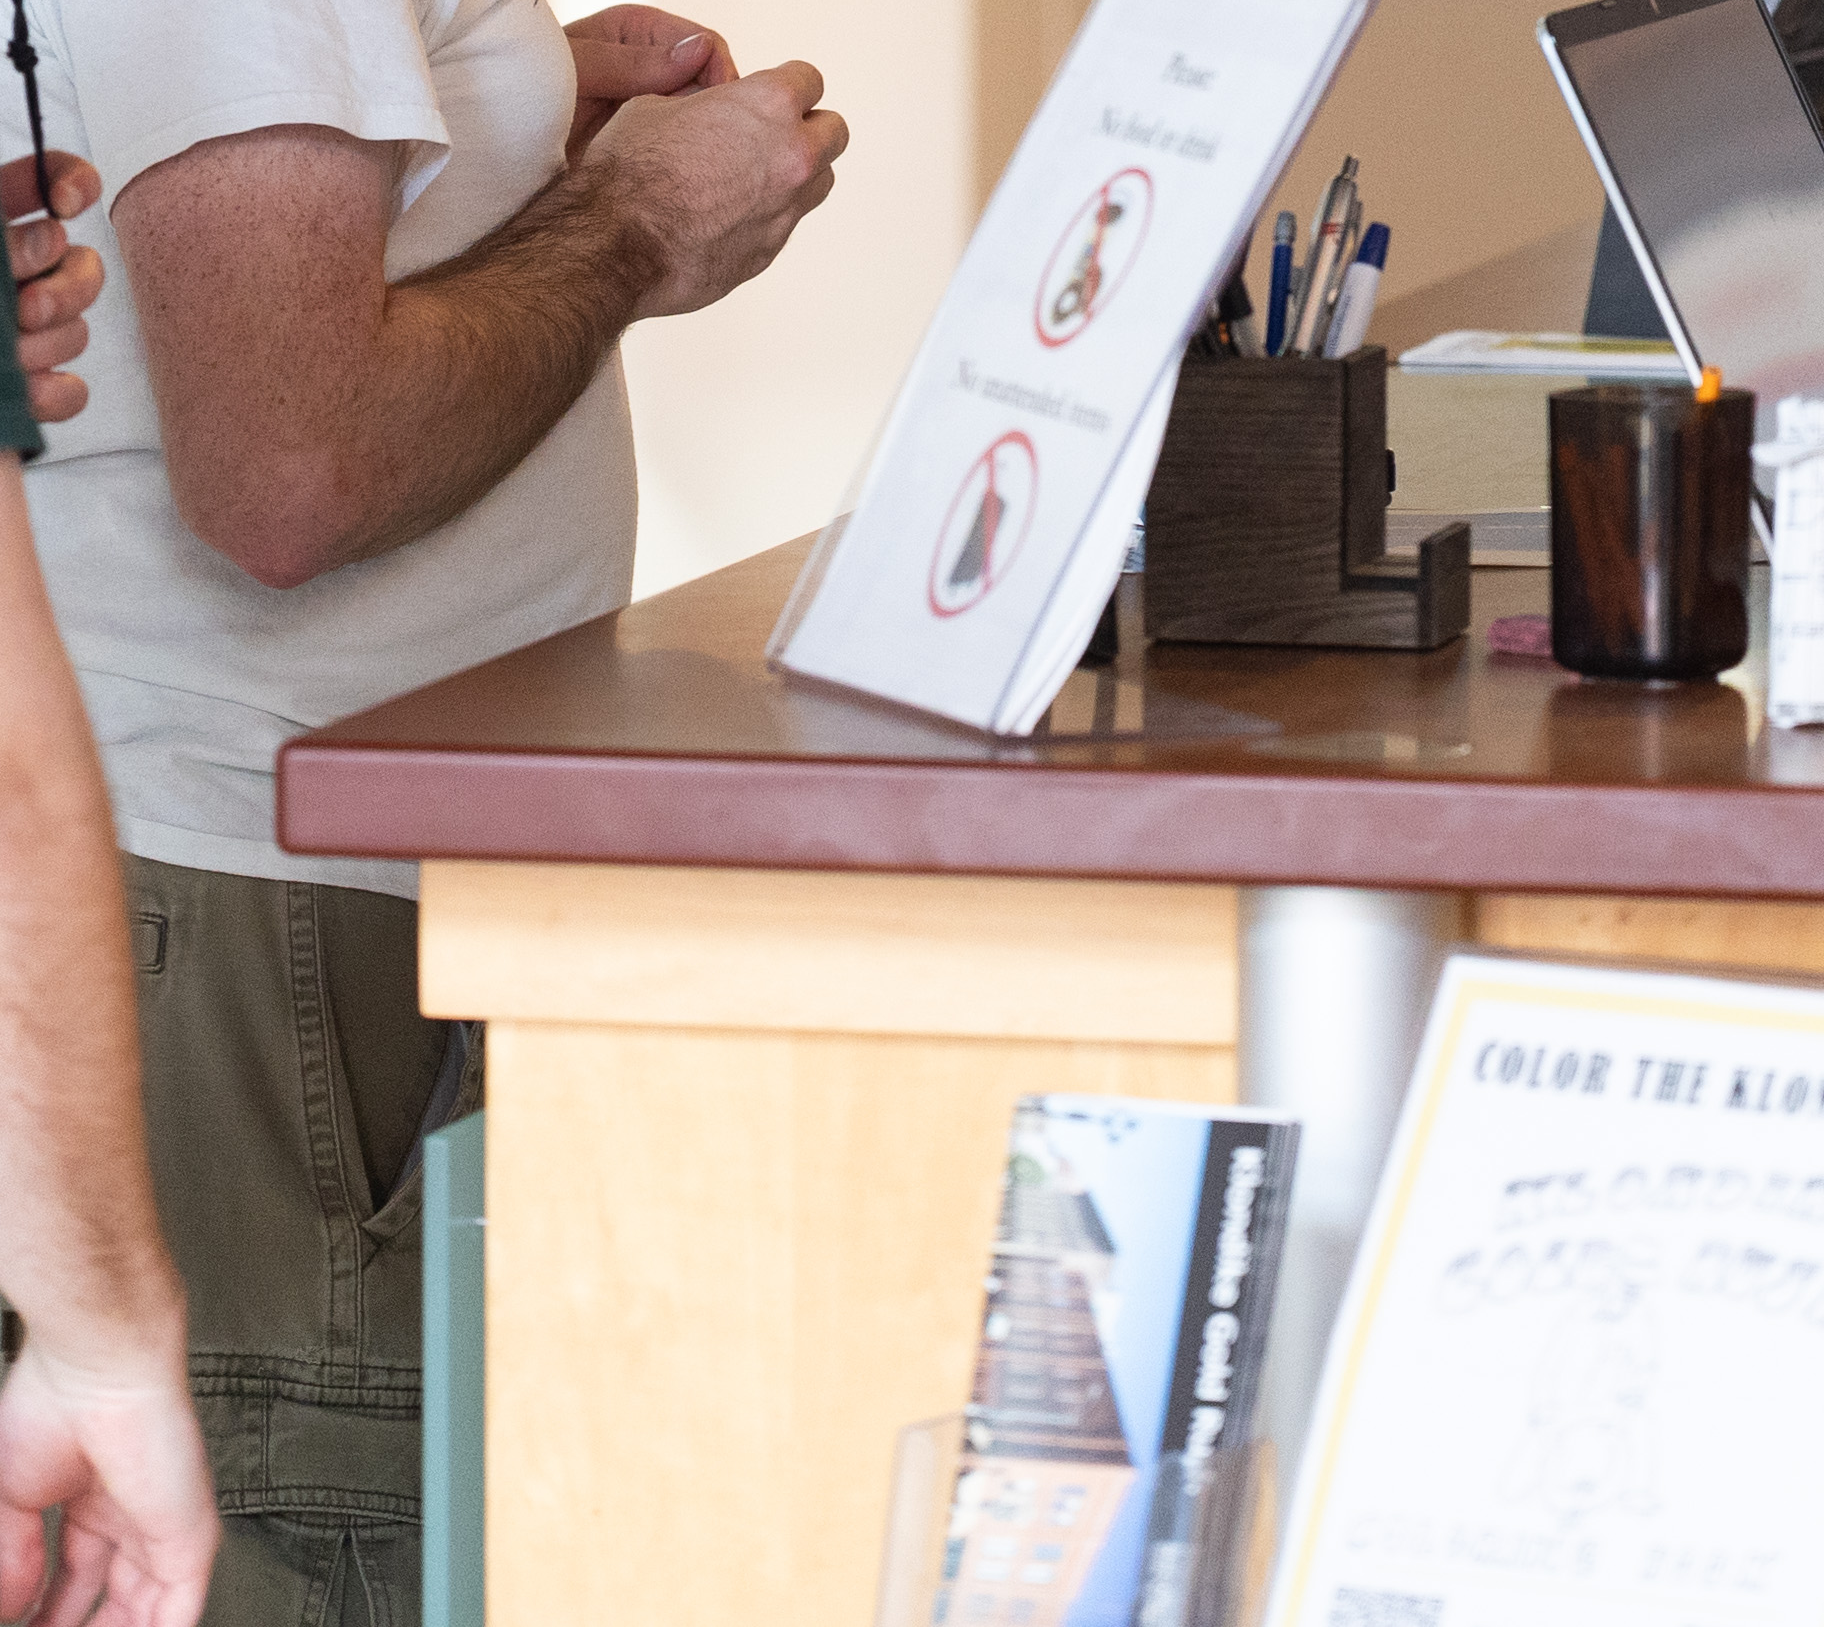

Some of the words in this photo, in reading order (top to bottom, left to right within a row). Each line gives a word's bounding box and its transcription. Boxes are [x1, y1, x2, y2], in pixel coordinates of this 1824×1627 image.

[1471, 1038, 1612, 1095] COLOR
[1630, 1055, 1710, 1107] THE
[1206, 1143, 1264, 1309] Klondike
[1192, 1313, 1240, 1402] Gold
